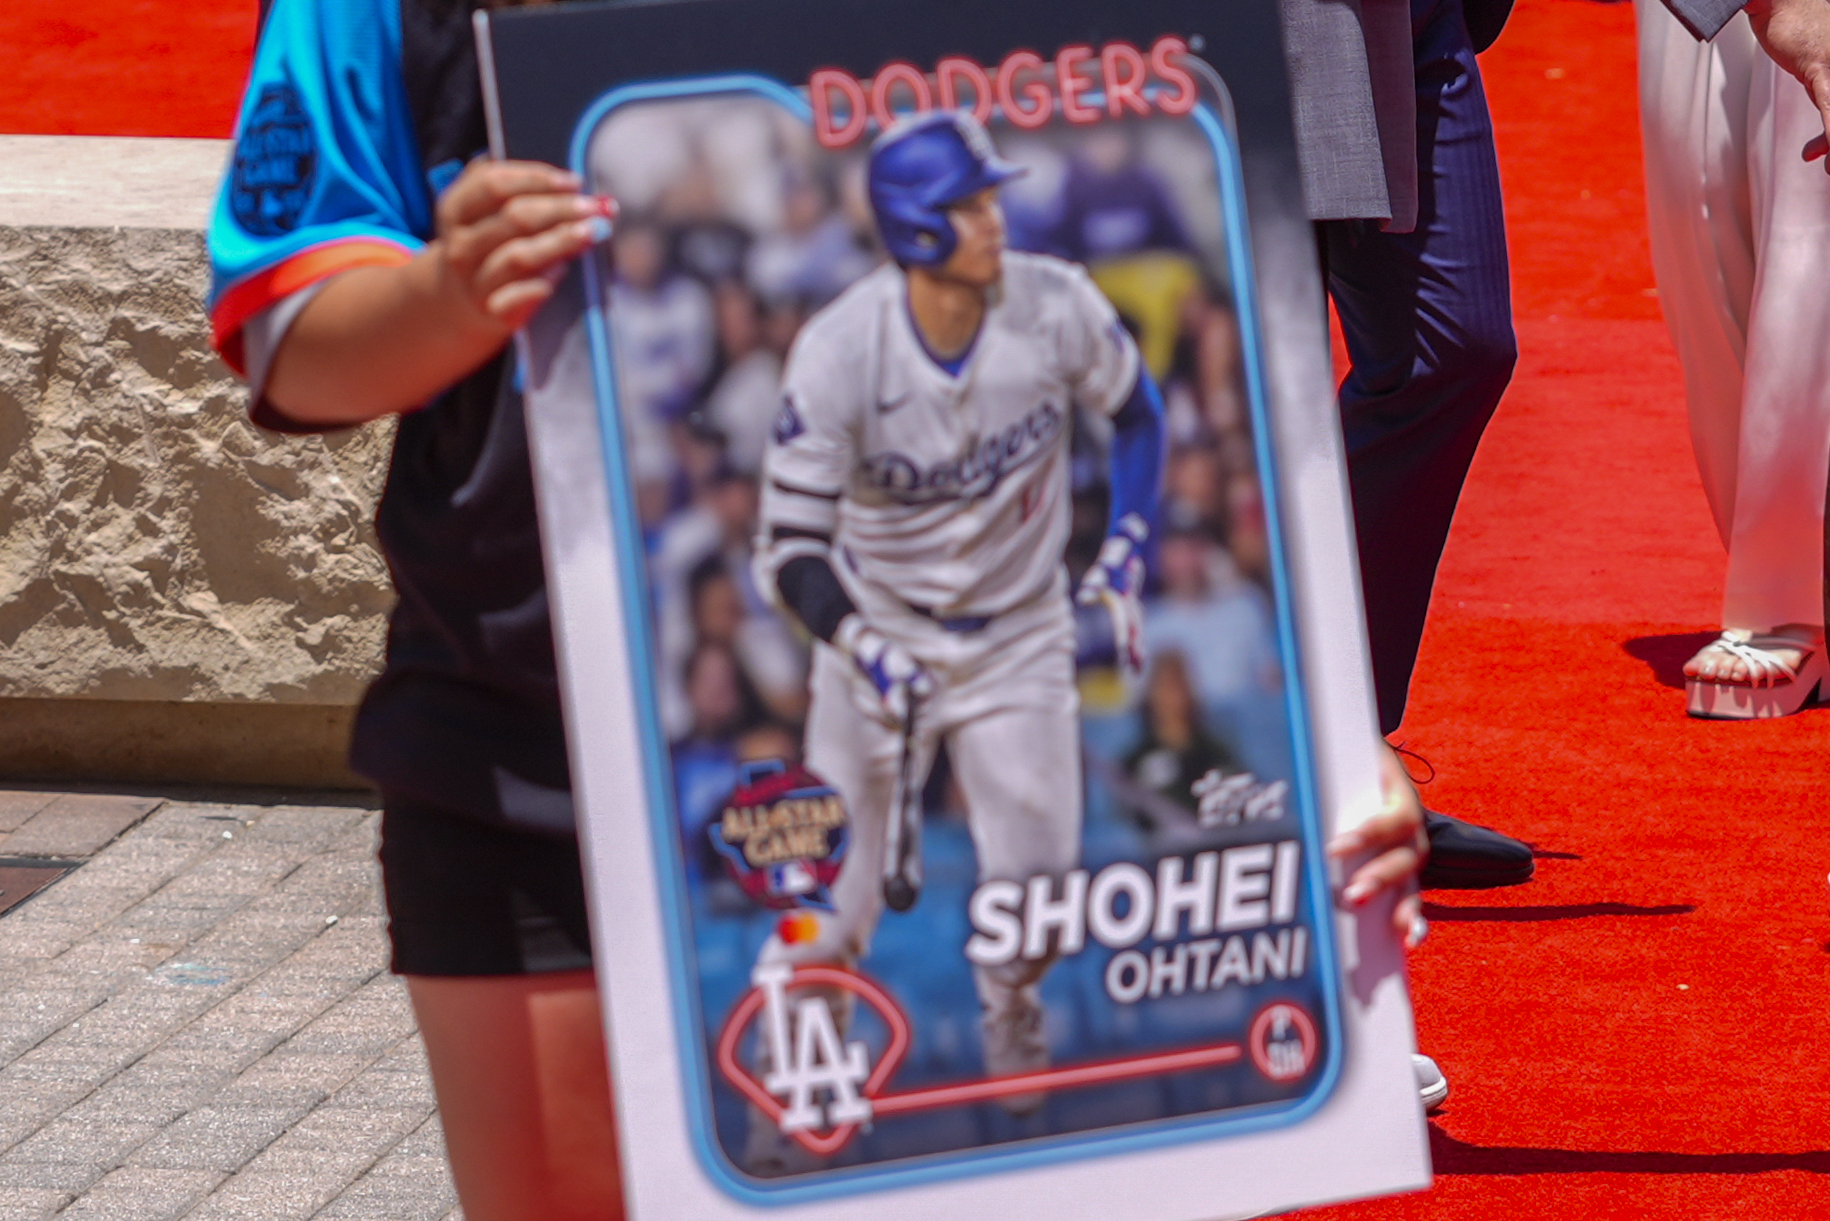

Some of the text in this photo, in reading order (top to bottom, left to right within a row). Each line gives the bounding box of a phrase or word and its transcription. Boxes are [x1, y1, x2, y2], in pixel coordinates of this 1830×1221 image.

[811, 36, 1196, 147] DODGERS
[859, 399, 1062, 504] Dodgers
[965, 841, 1299, 966] SHOHEI
[1105, 926, 1308, 1004] OHTANI
[752, 962, 874, 1130] LA
